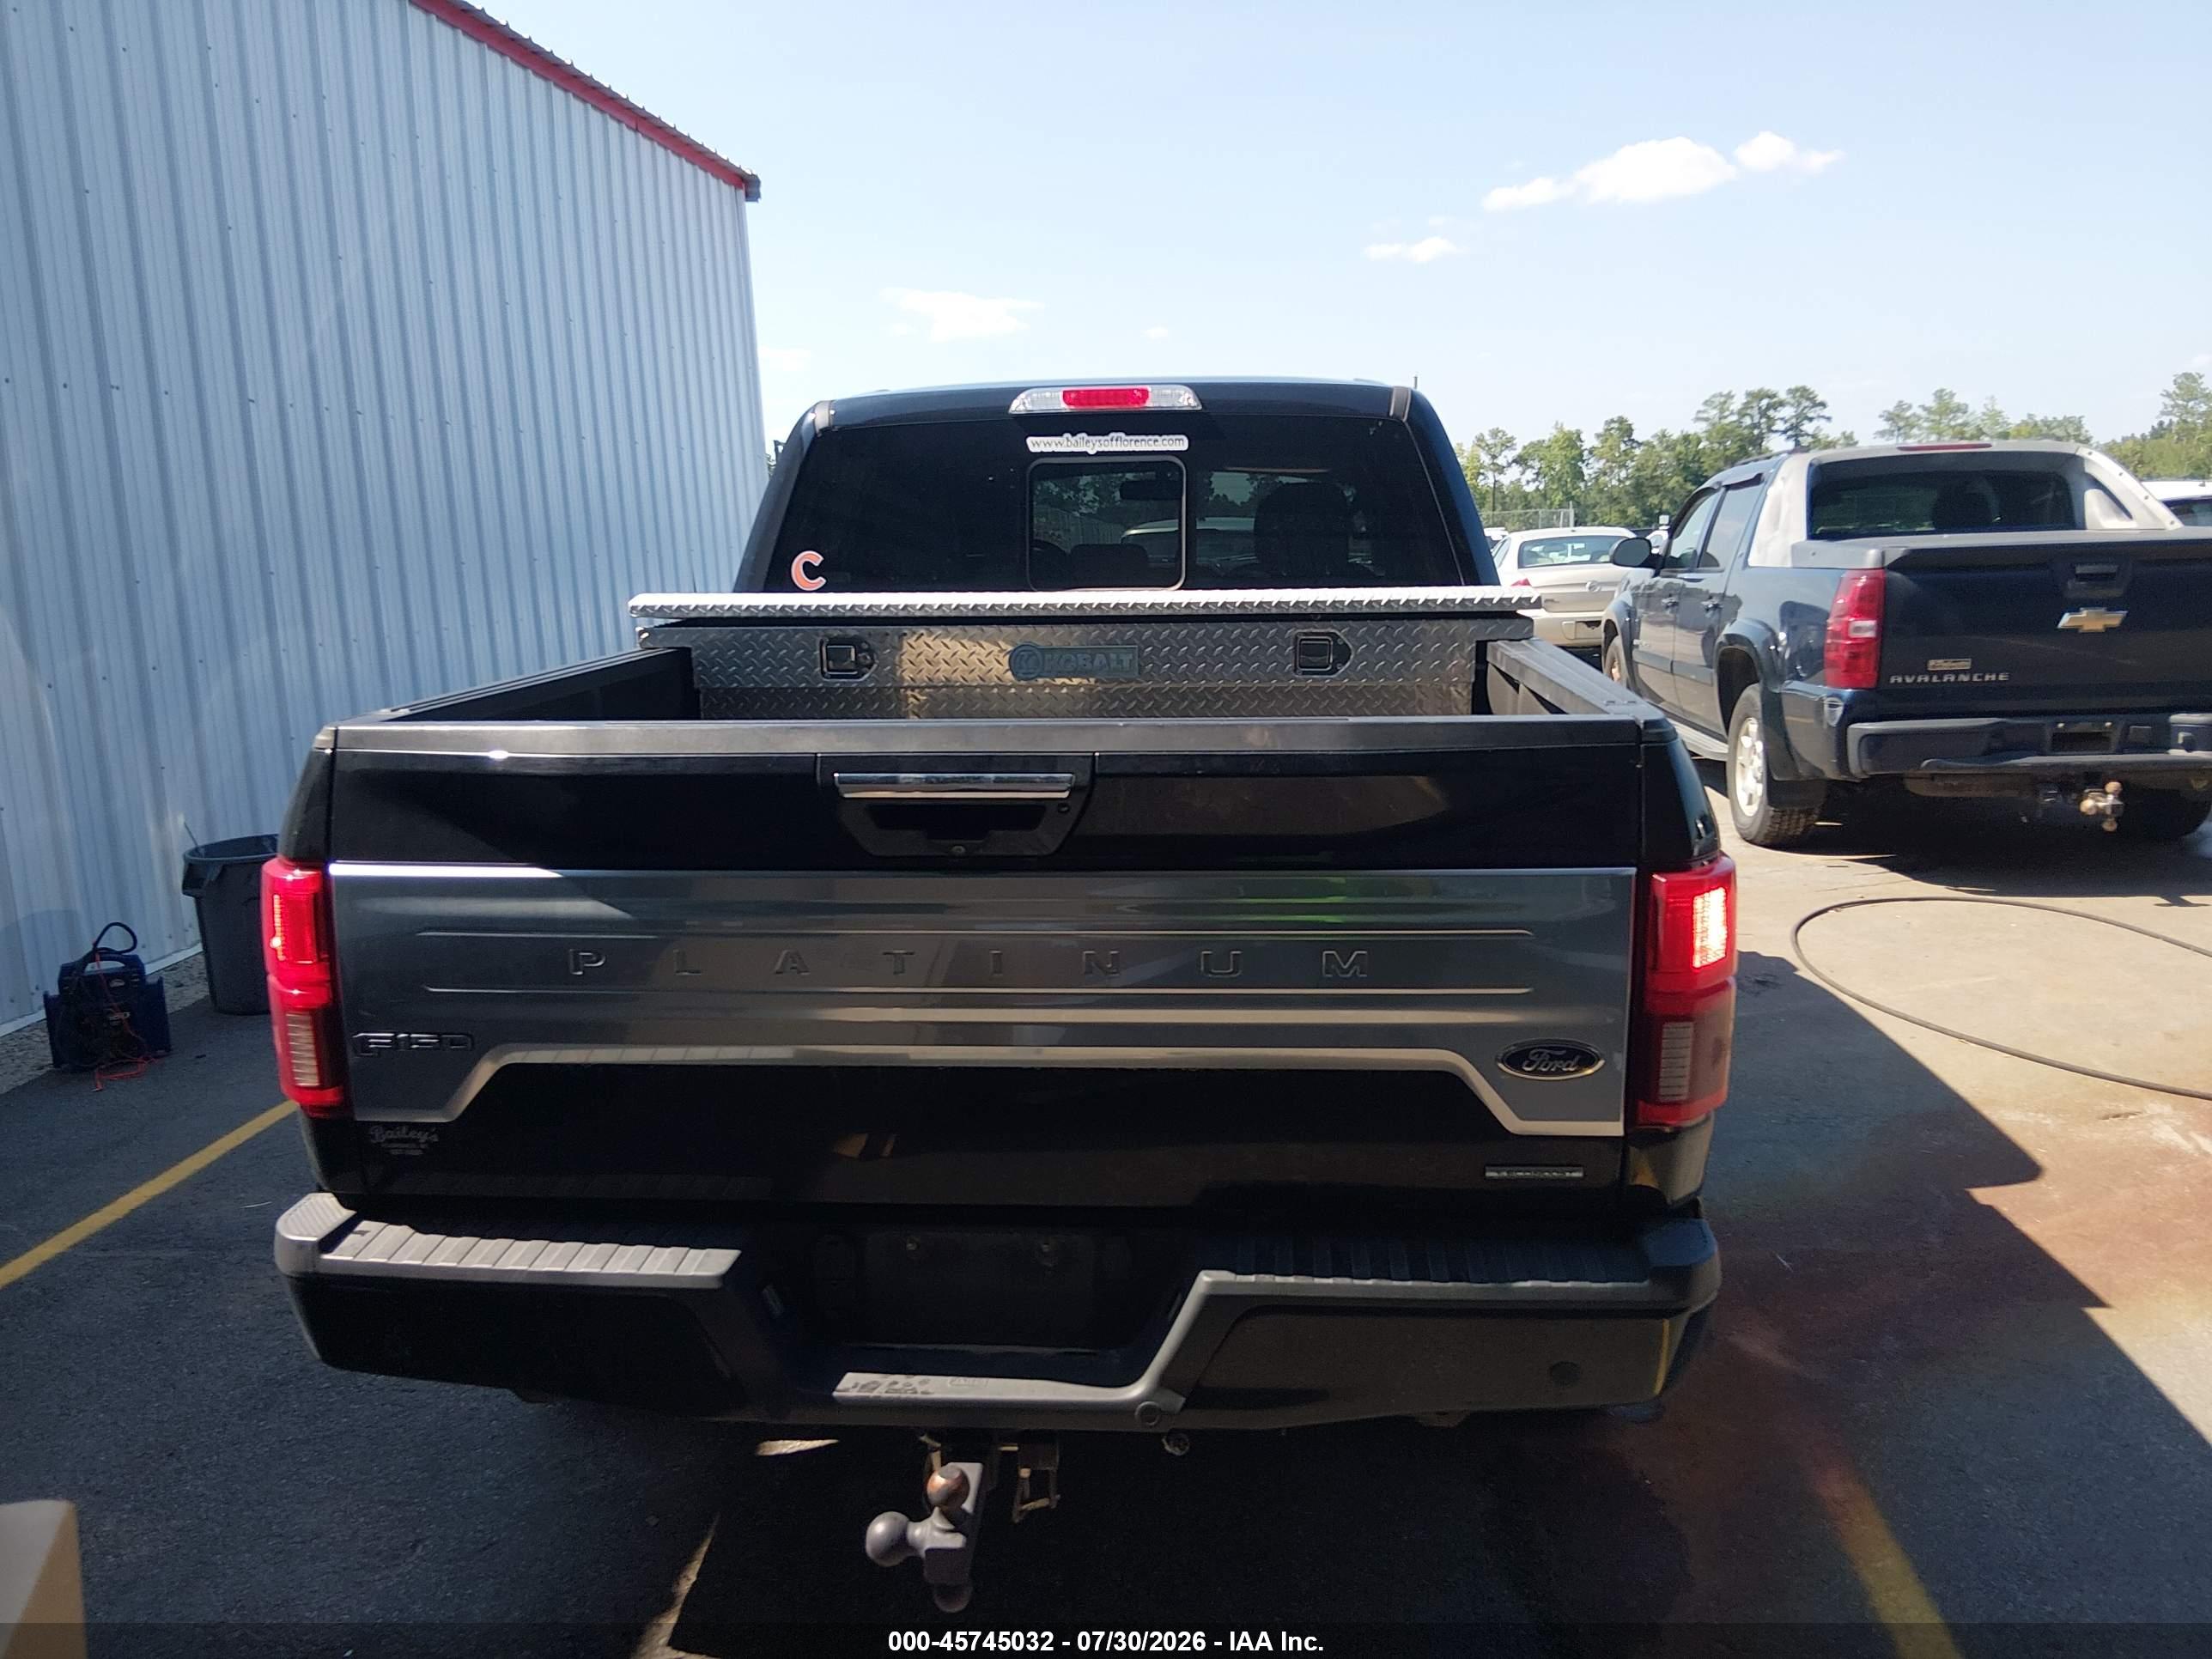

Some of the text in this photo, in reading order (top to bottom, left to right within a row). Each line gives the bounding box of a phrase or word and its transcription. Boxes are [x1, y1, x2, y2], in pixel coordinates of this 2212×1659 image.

[1030, 435, 1184, 451] www.baileysofflorence.com
[791, 550, 827, 591] C
[1044, 652, 1133, 672] KOBALT
[1889, 672, 2010, 684] AVALANCHE
[568, 948, 1368, 977] PLATINUM
[1522, 1048, 1579, 1072] Ford
